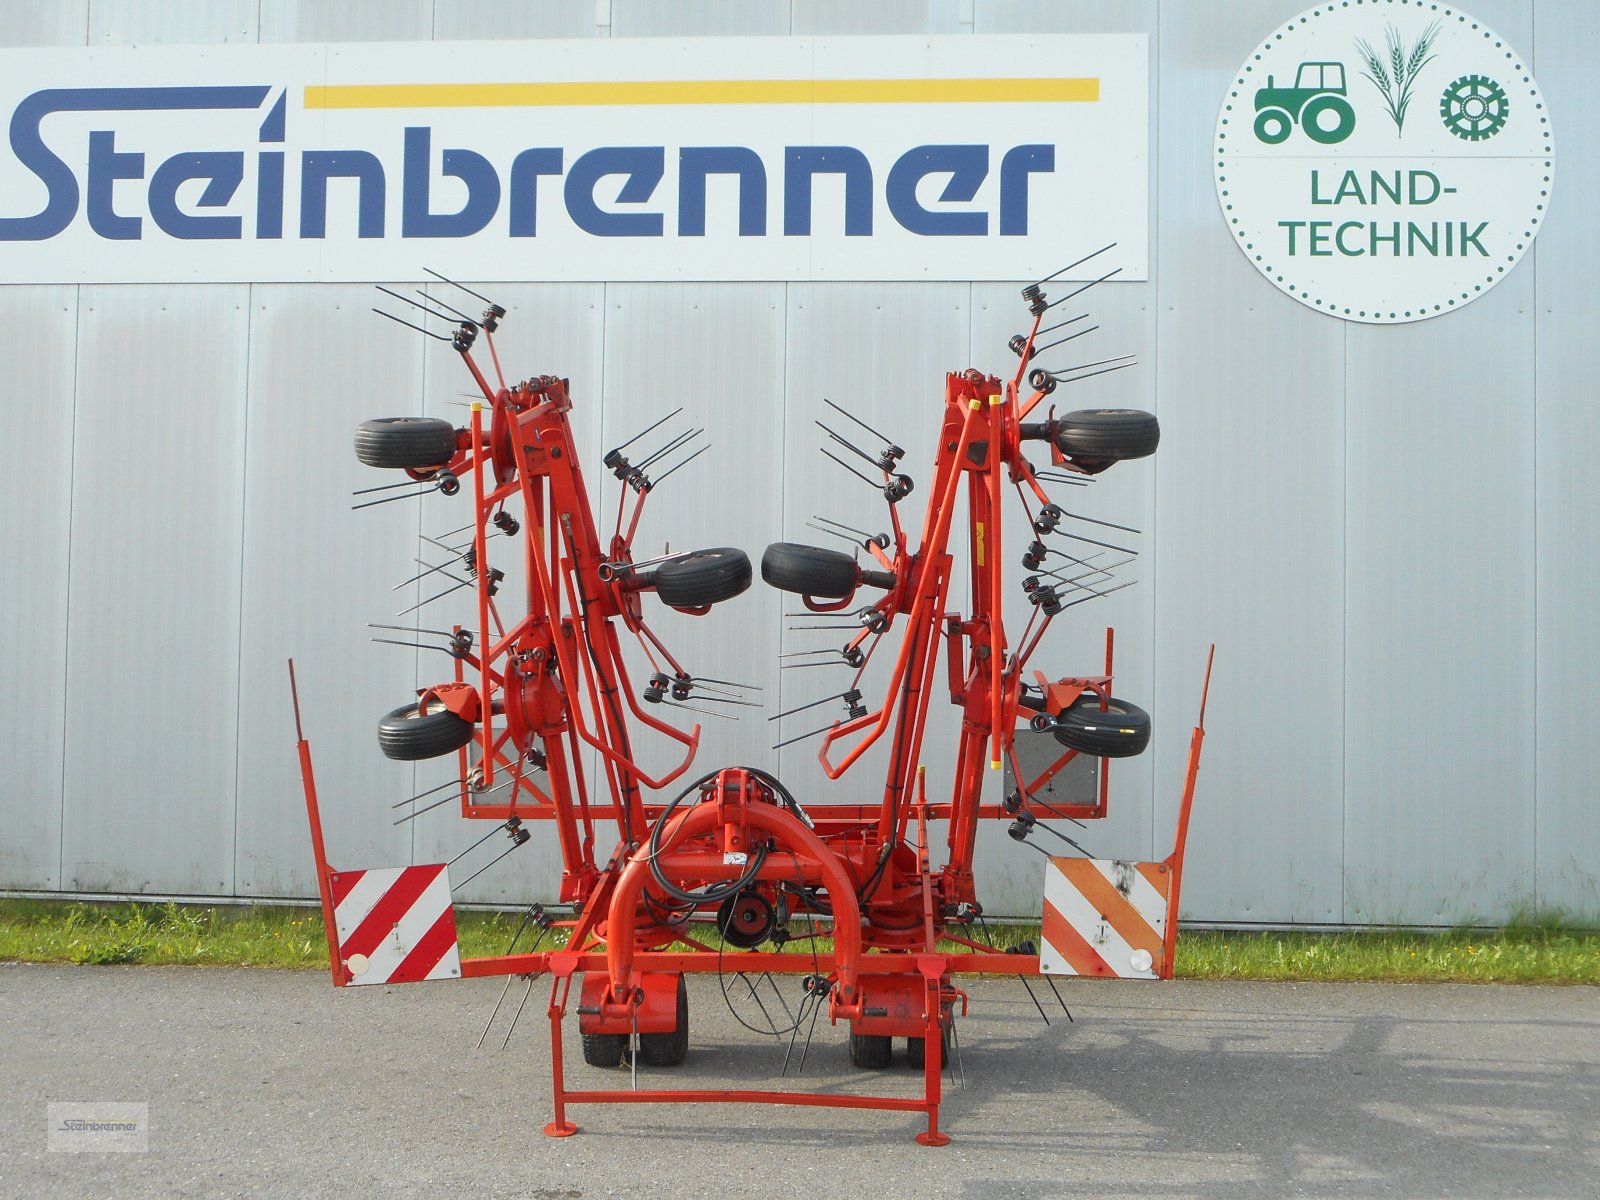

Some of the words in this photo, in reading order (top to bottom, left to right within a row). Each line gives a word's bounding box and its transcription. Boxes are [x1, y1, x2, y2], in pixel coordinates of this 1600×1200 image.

[0, 85, 1055, 241] Steinbrenner
[1311, 170, 1457, 205] LAND-
[1278, 221, 1490, 257] TECHNIK
